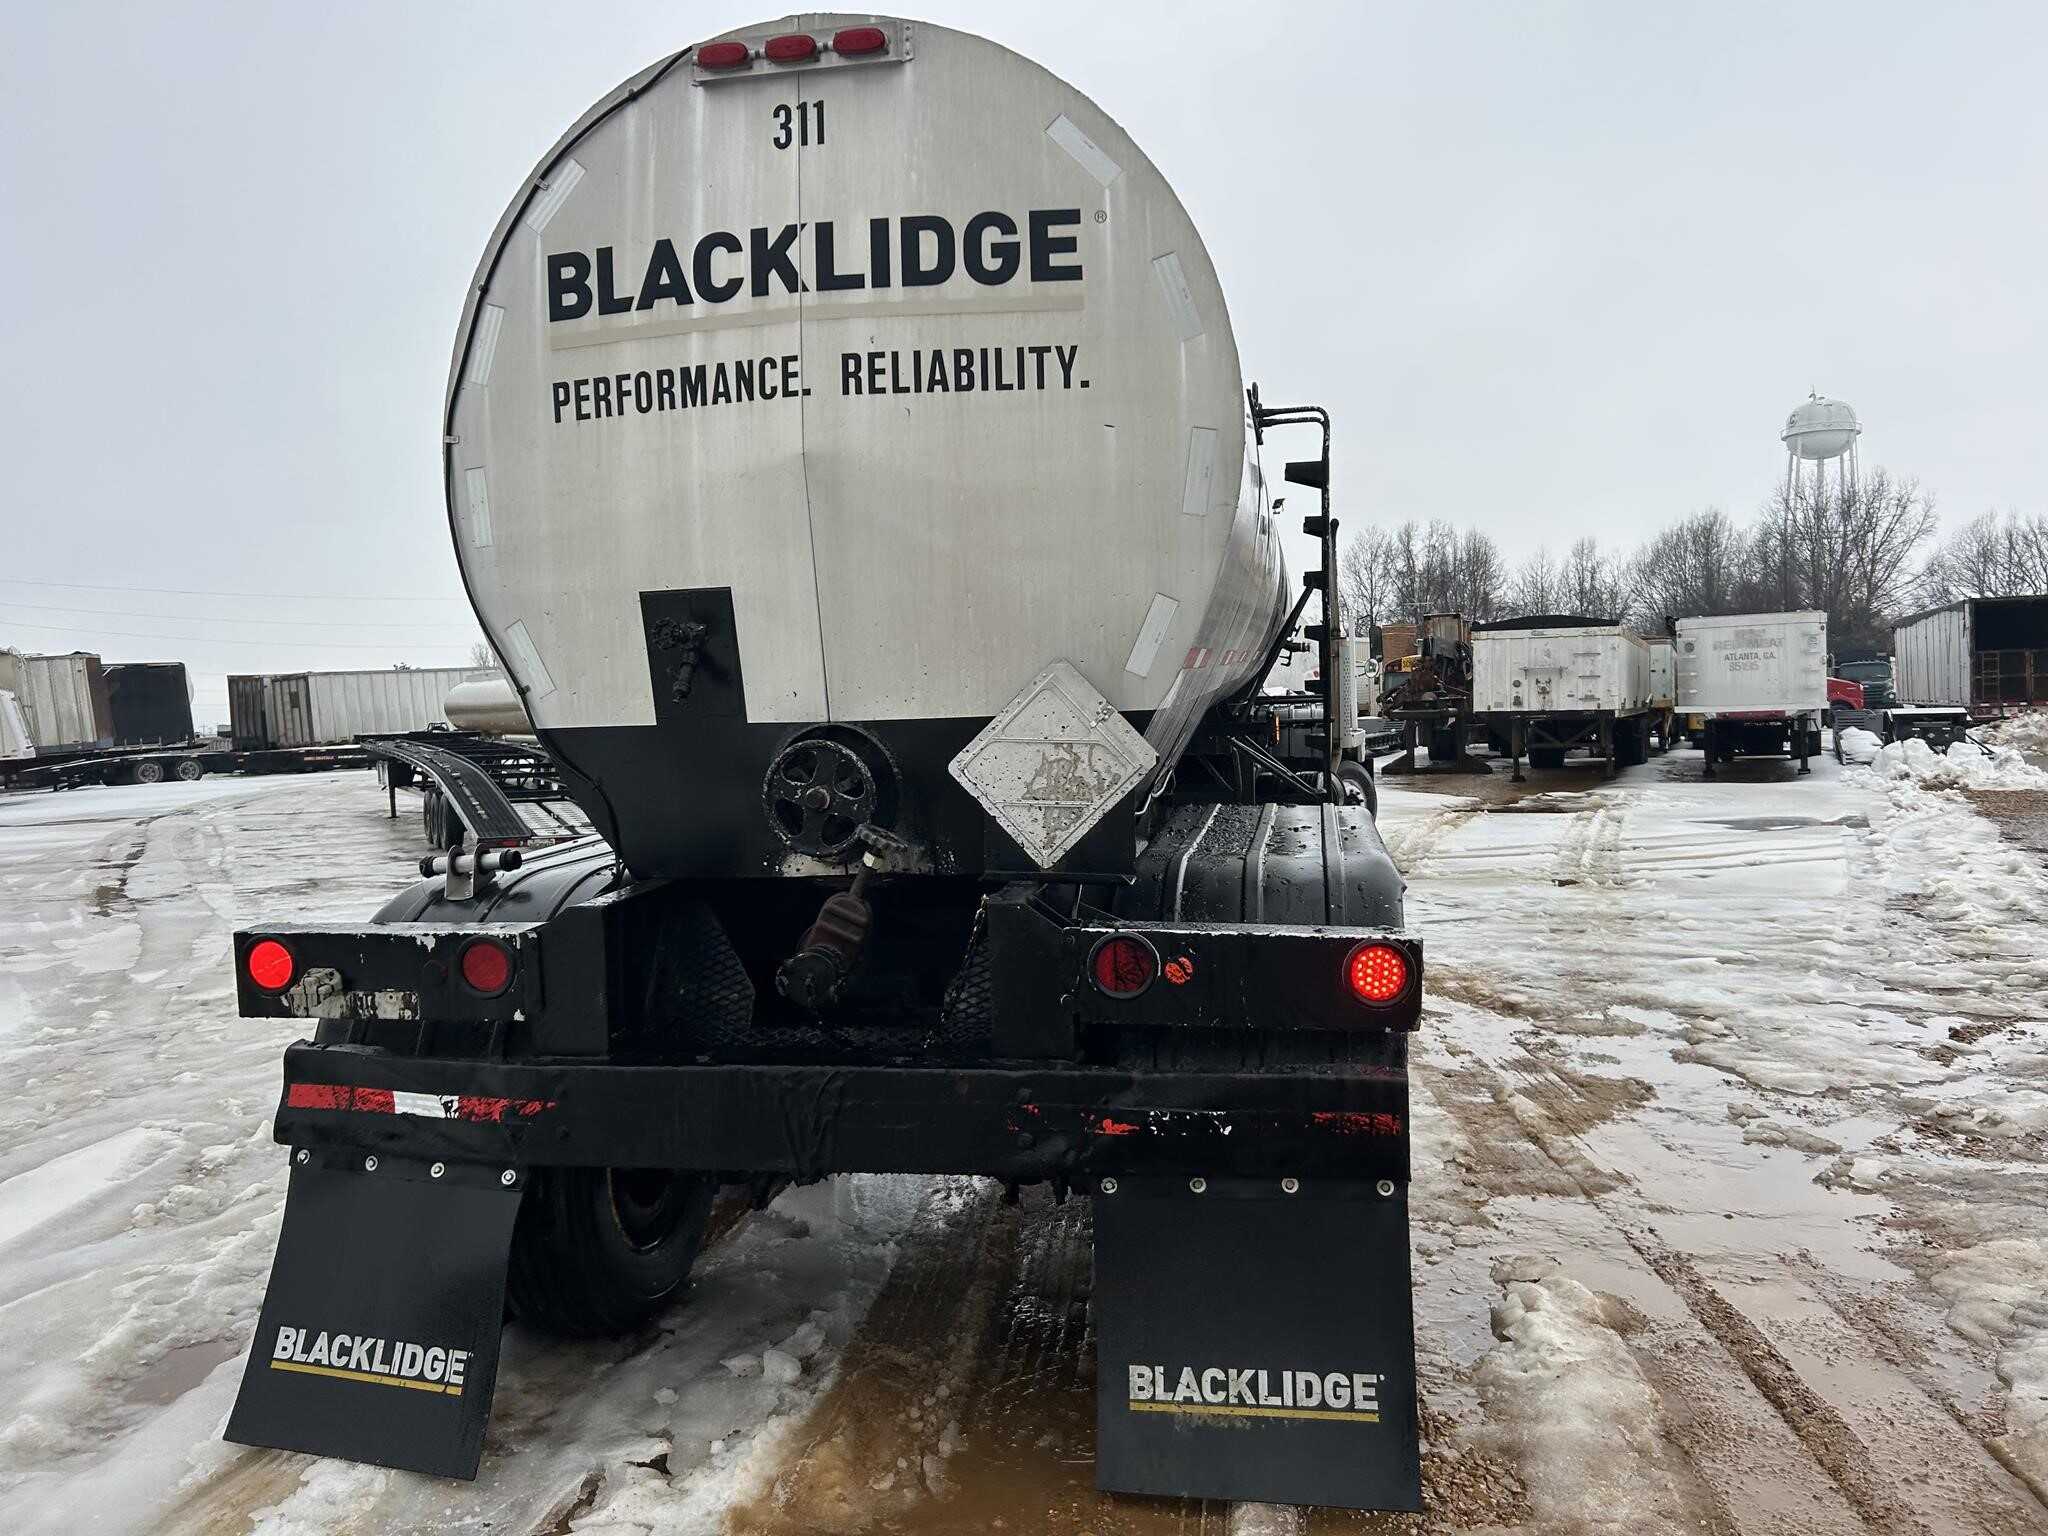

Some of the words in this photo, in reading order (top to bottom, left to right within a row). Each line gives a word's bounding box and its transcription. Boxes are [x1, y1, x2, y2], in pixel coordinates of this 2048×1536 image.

[772, 99, 825, 149] 311
[547, 208, 1083, 323] BLACKLIDGE
[552, 354, 812, 424] PERFORMANCE.
[841, 345, 1090, 396] RELIABILITY.
[272, 1326, 468, 1385] BLACKLIDGE
[1128, 1364, 1379, 1411] BLACKLIDGE
